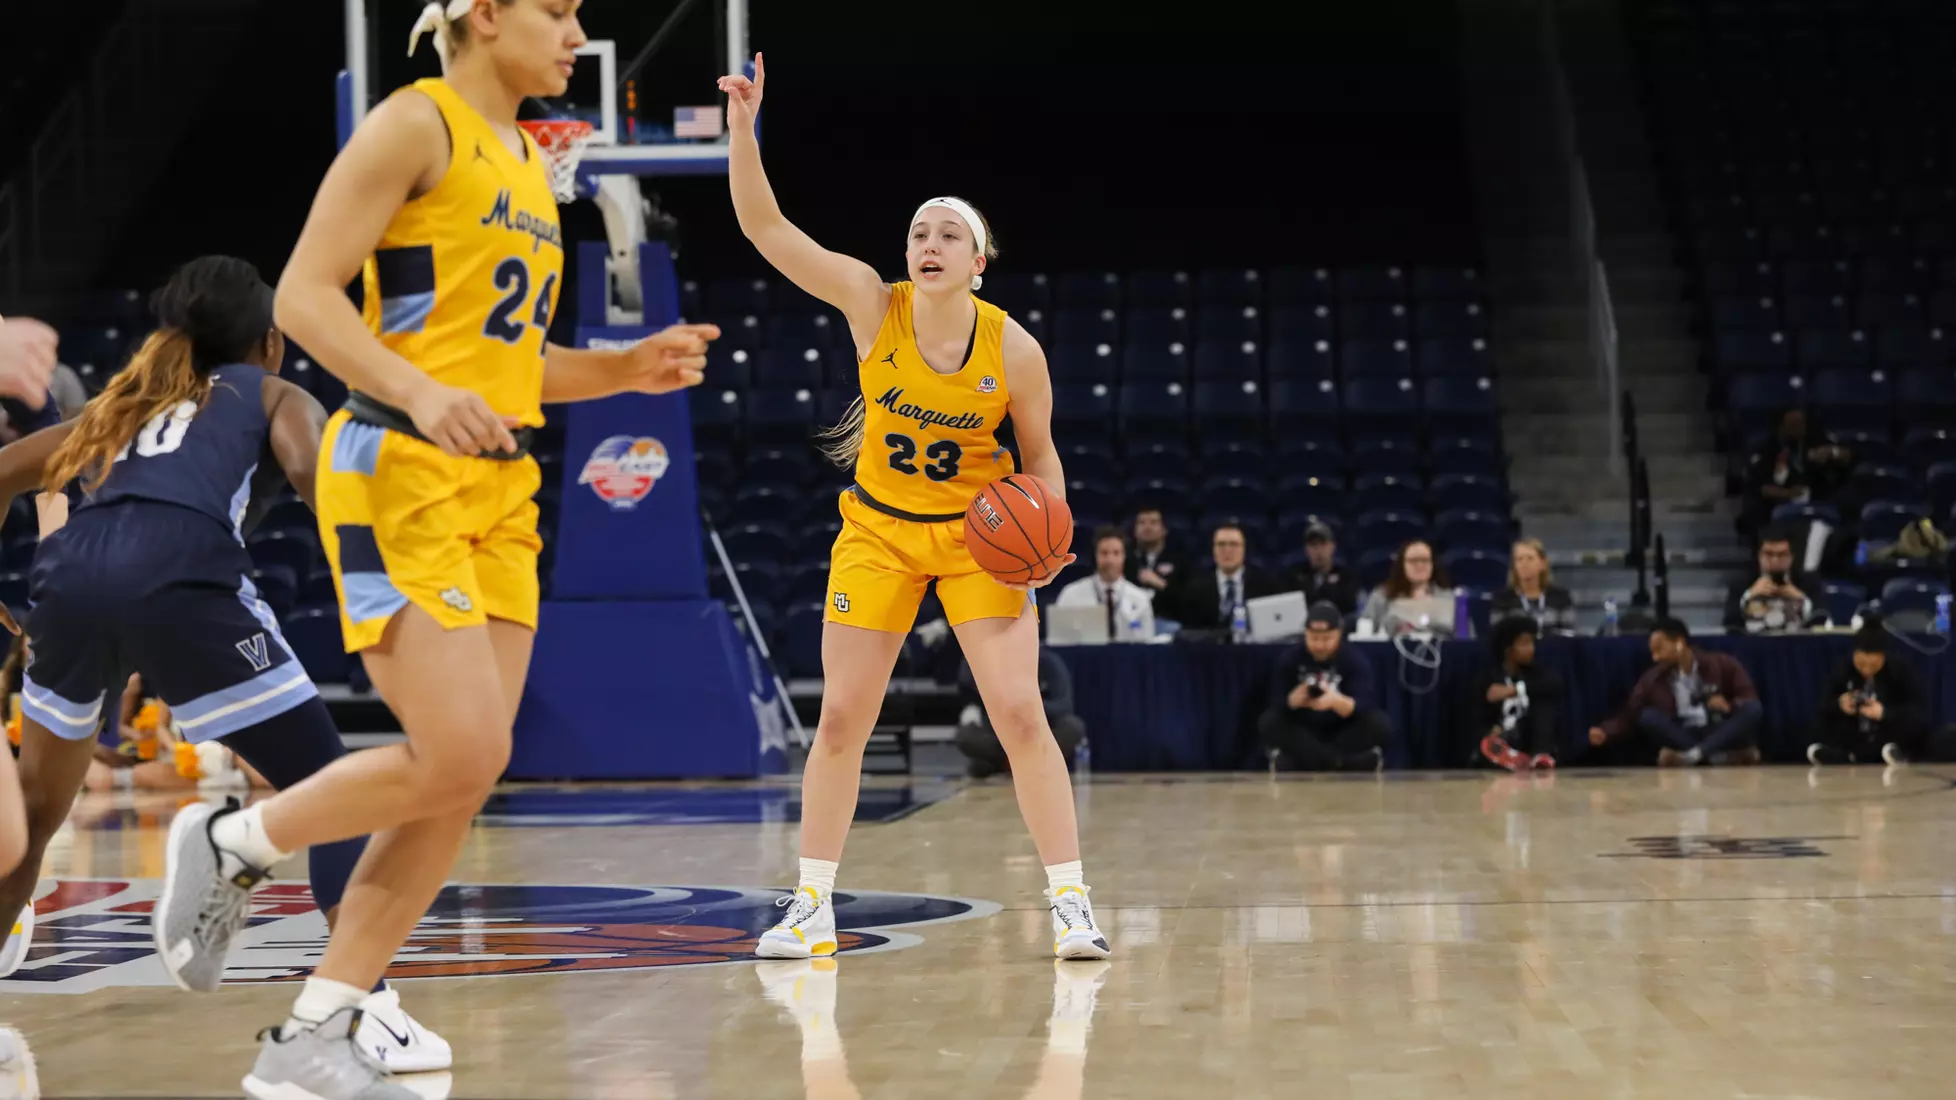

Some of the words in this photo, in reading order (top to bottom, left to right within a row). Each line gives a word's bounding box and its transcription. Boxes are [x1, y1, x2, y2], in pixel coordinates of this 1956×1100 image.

[482, 256, 556, 358] 24
[982, 377, 994, 387] 40
[875, 386, 984, 430] Marquette
[885, 432, 963, 482] 23
[833, 591, 850, 613] MU
[235, 632, 271, 672] V
